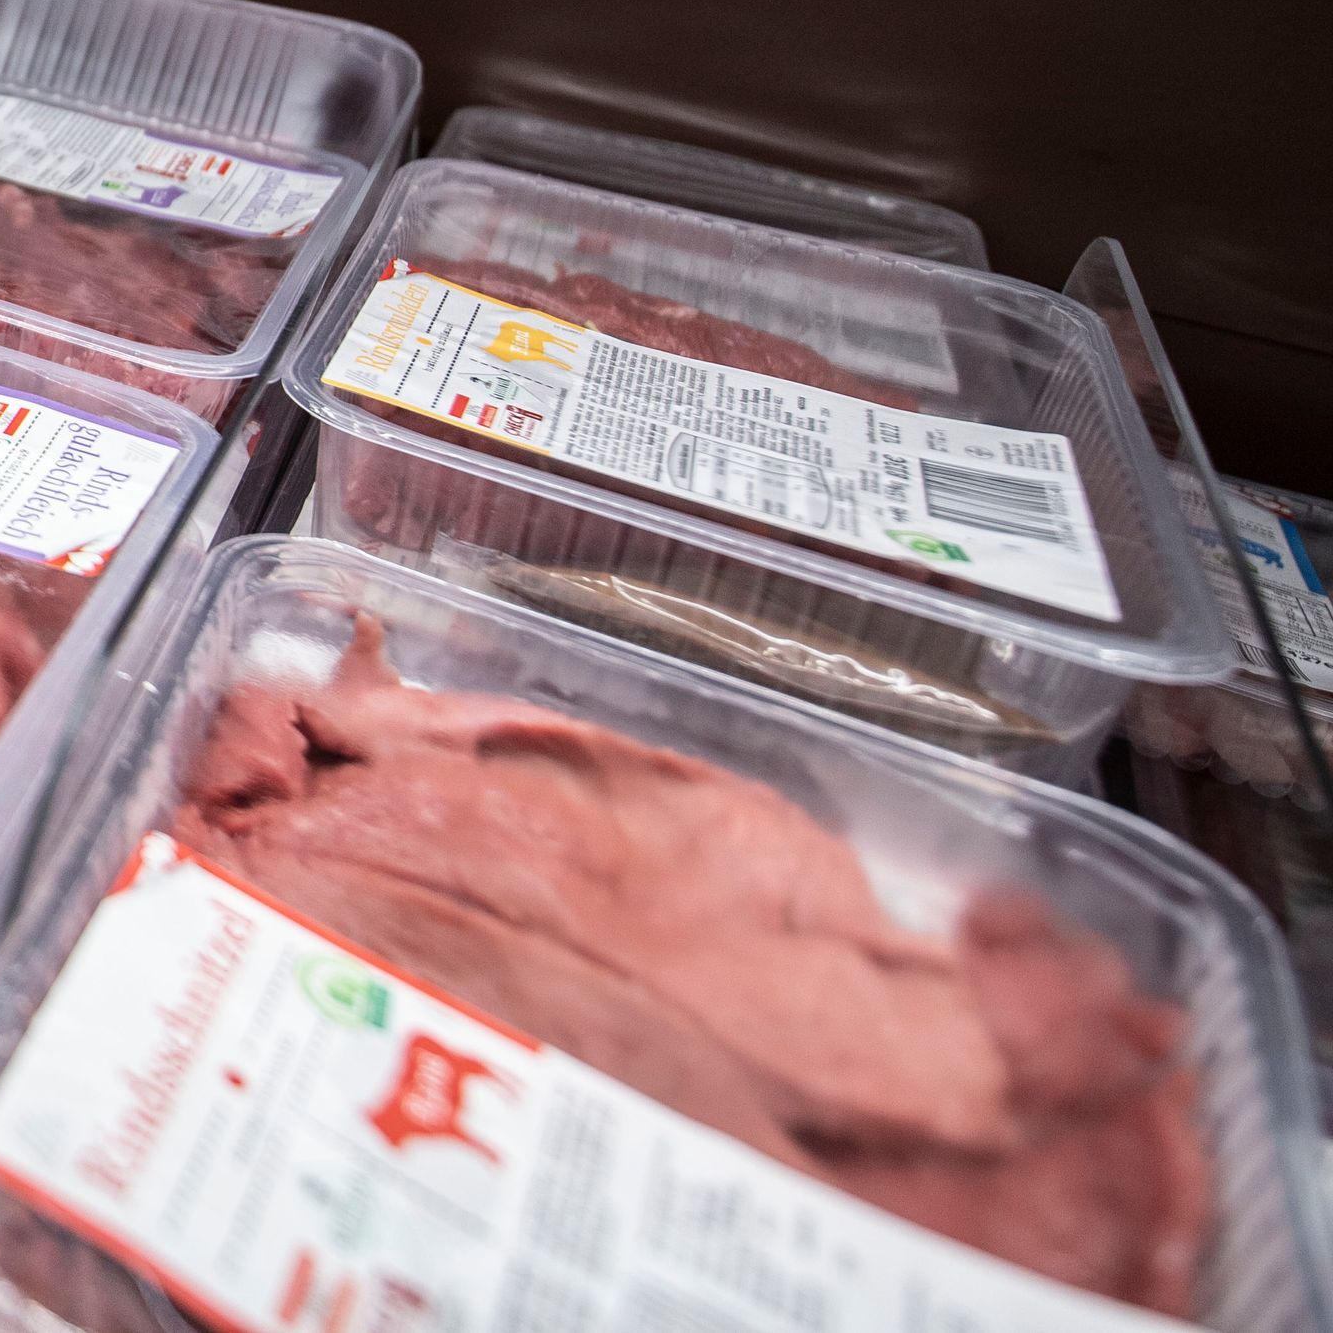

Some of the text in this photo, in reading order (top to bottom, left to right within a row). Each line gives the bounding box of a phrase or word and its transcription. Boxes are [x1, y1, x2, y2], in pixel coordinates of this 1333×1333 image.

[355, 282, 431, 373] Rindsrouladen
[509, 327, 531, 356] Rind
[502, 404, 526, 436] CHECK
[2, 421, 103, 541] gulaschfleisch
